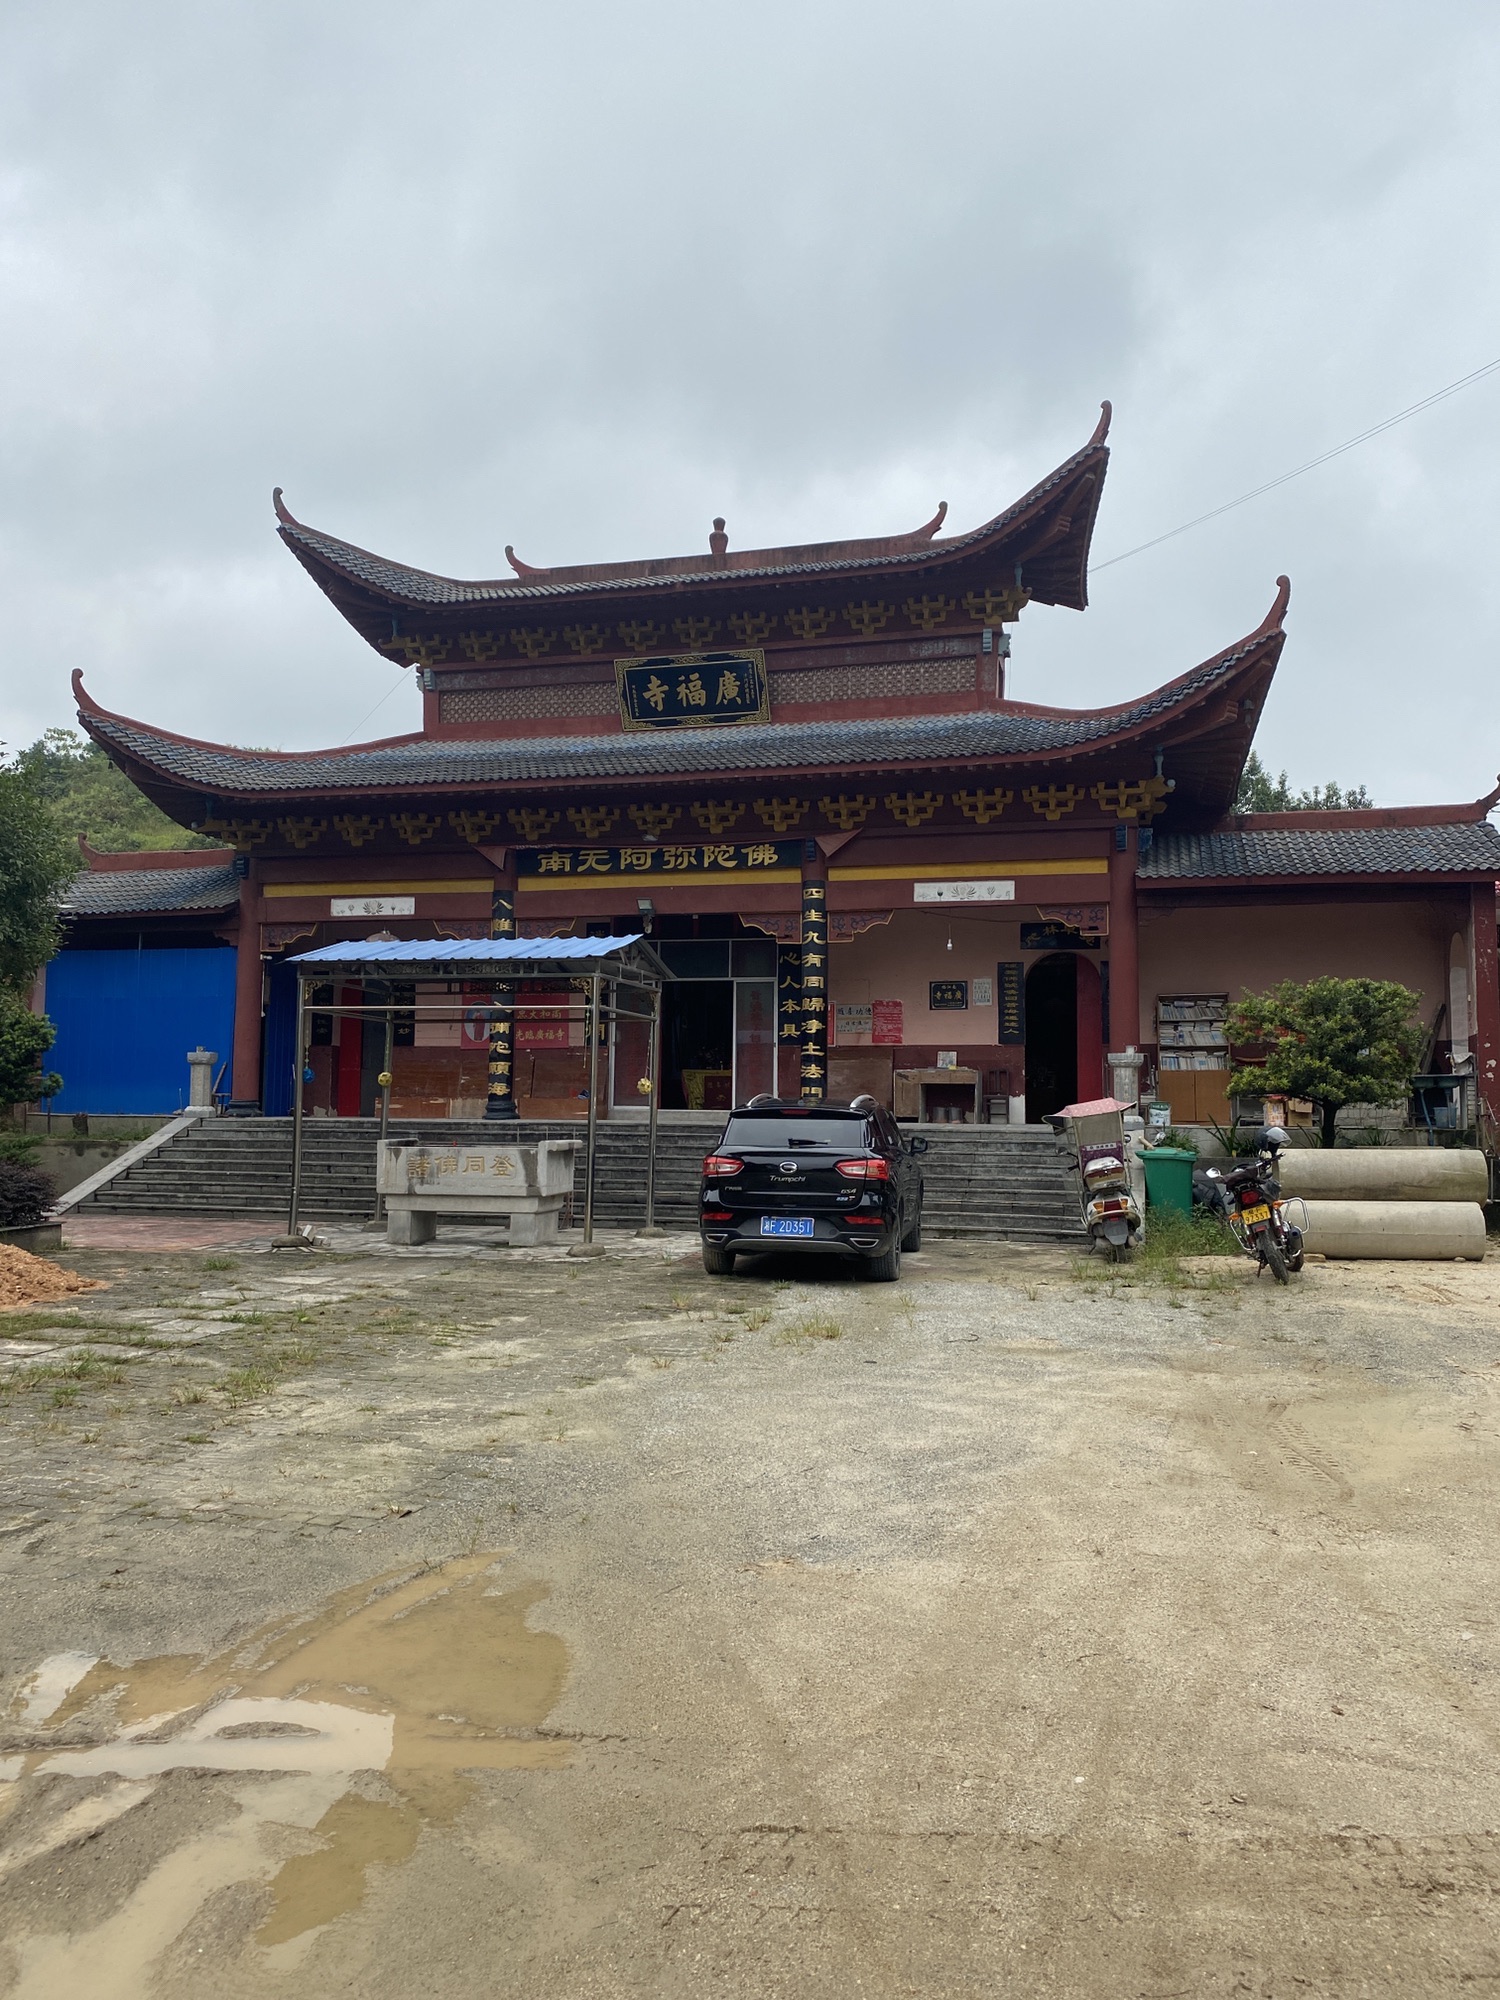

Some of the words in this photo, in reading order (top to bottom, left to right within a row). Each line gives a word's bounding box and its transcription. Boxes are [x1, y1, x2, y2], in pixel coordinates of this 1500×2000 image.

[642, 670, 742, 712] 廣福寺
[537, 844, 779, 873] 南无阿弥陀佛
[407, 1155, 515, 1178] 諸佛同登
[769, 1175, 807, 1183] Trumpchi
